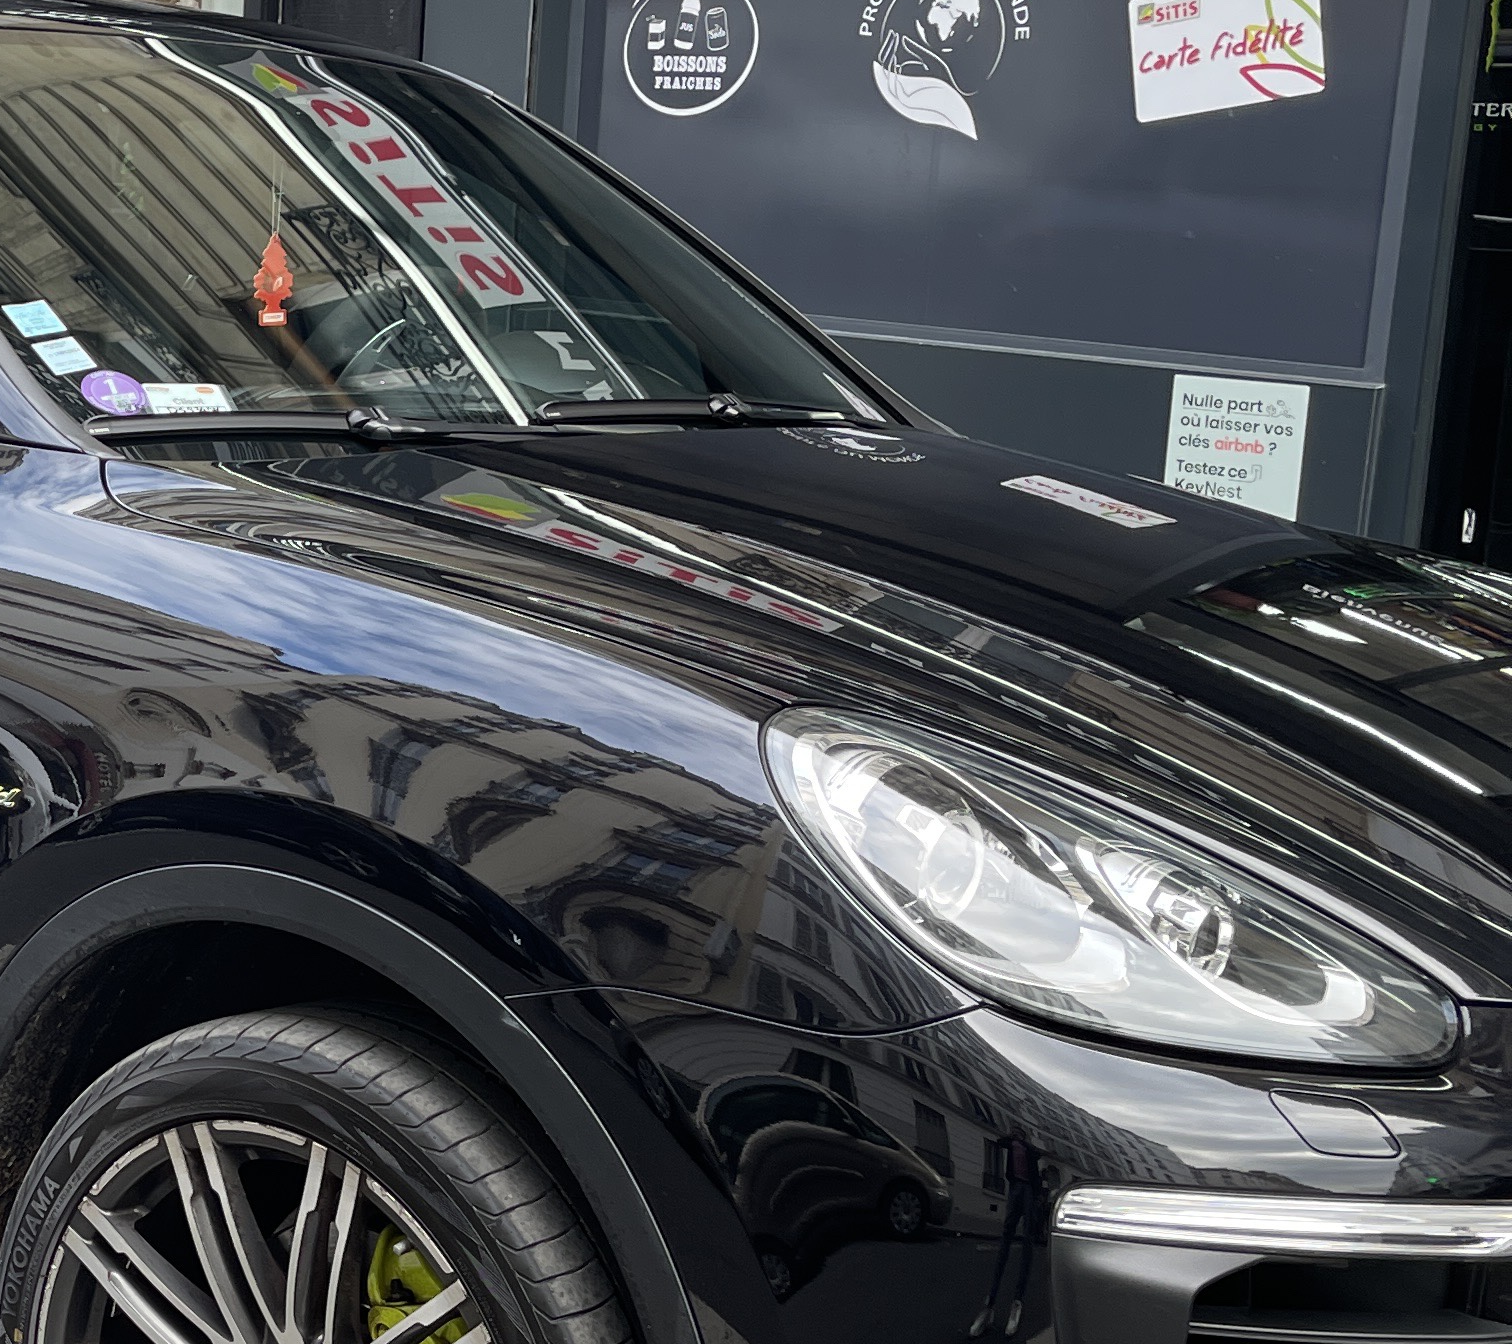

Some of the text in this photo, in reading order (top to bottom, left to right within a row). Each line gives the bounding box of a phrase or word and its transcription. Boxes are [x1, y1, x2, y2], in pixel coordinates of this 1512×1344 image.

[652, 55, 727, 74] BOISSONS
[1139, 37, 1201, 74] Carte
[654, 76, 722, 91] FRAICHES
[1182, 392, 1264, 415] Nulle part
[1180, 413, 1294, 437] où laisser vos
[1178, 433, 1210, 449] clés
[1214, 436, 1265, 454] airbnb
[1176, 459, 1248, 479] Testez ce
[1, 1175, 61, 1317] YOKOHAMA
